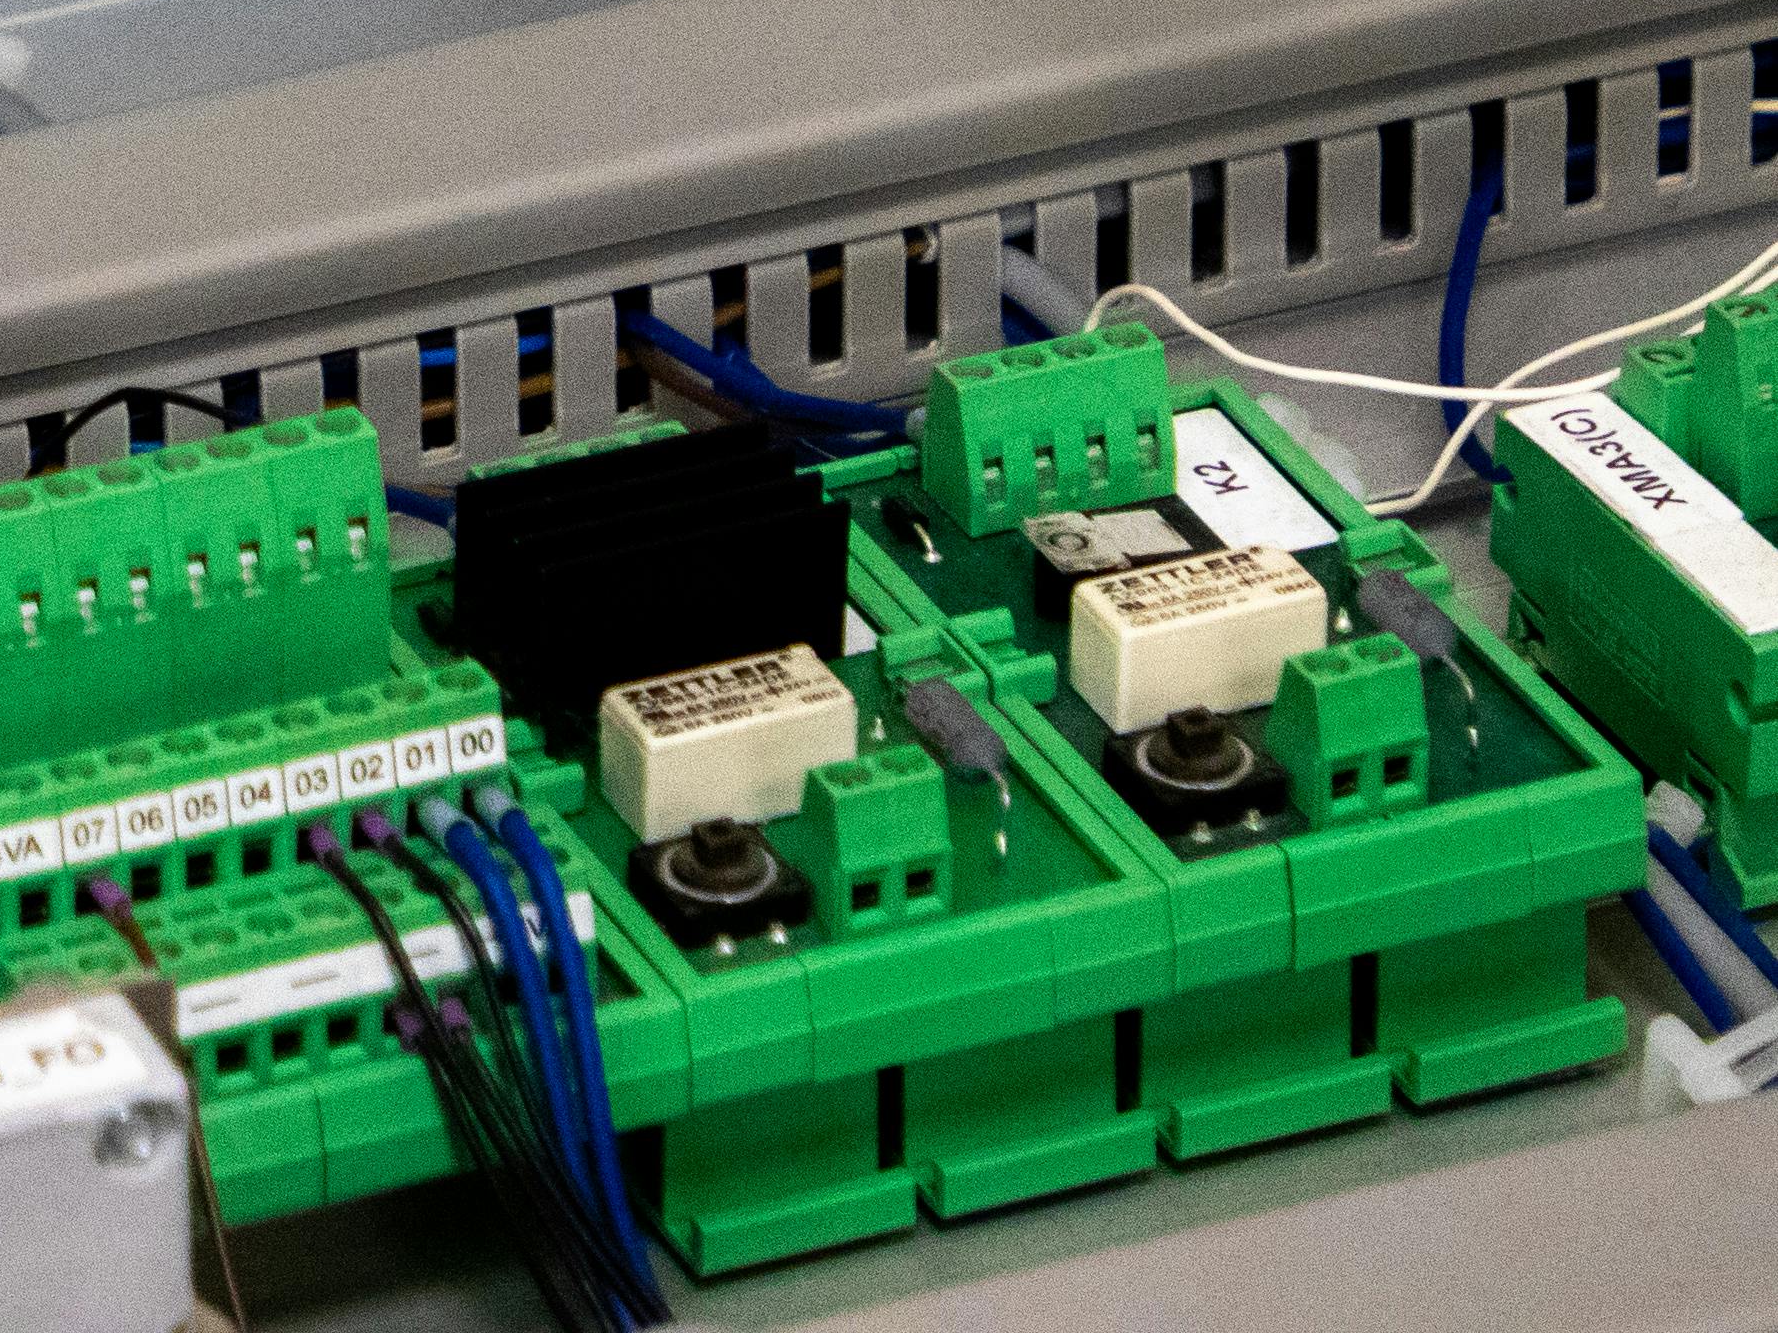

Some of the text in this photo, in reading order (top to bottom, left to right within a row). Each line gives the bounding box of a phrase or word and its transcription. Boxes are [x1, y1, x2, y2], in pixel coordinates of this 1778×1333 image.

[1192, 459, 1250, 496] K2
[1550, 408, 1689, 510] XMA3(C)
[1097, 552, 1254, 594] ZETTLER
[72, 817, 106, 848] 07
[128, 805, 165, 836] 06
[183, 793, 219, 823] 05
[239, 779, 273, 810] 04
[294, 767, 330, 797] 03
[349, 754, 385, 784] 02
[404, 740, 438, 772] 01
[460, 727, 496, 758] 00
